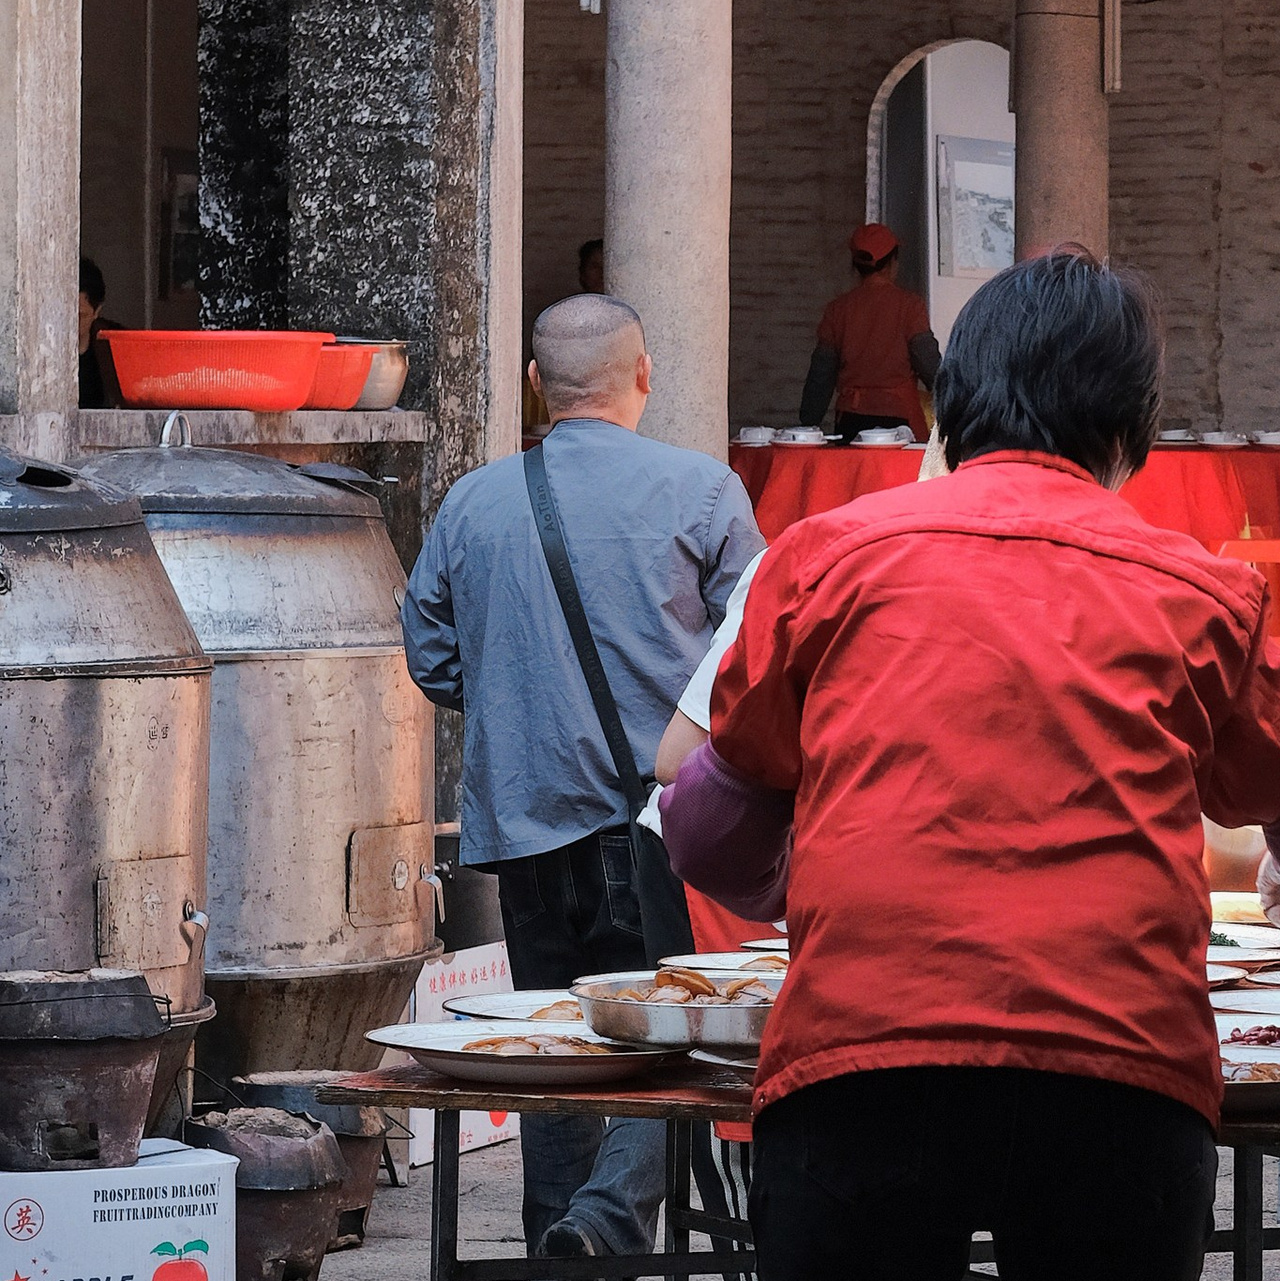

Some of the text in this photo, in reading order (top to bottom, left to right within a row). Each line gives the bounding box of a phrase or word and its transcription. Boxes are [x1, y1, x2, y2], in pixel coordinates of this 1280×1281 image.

[536, 485, 555, 531] AoTian
[93, 1182, 217, 1203] PROSPEROUS DRAGON
[11, 1204, 37, 1235] 英
